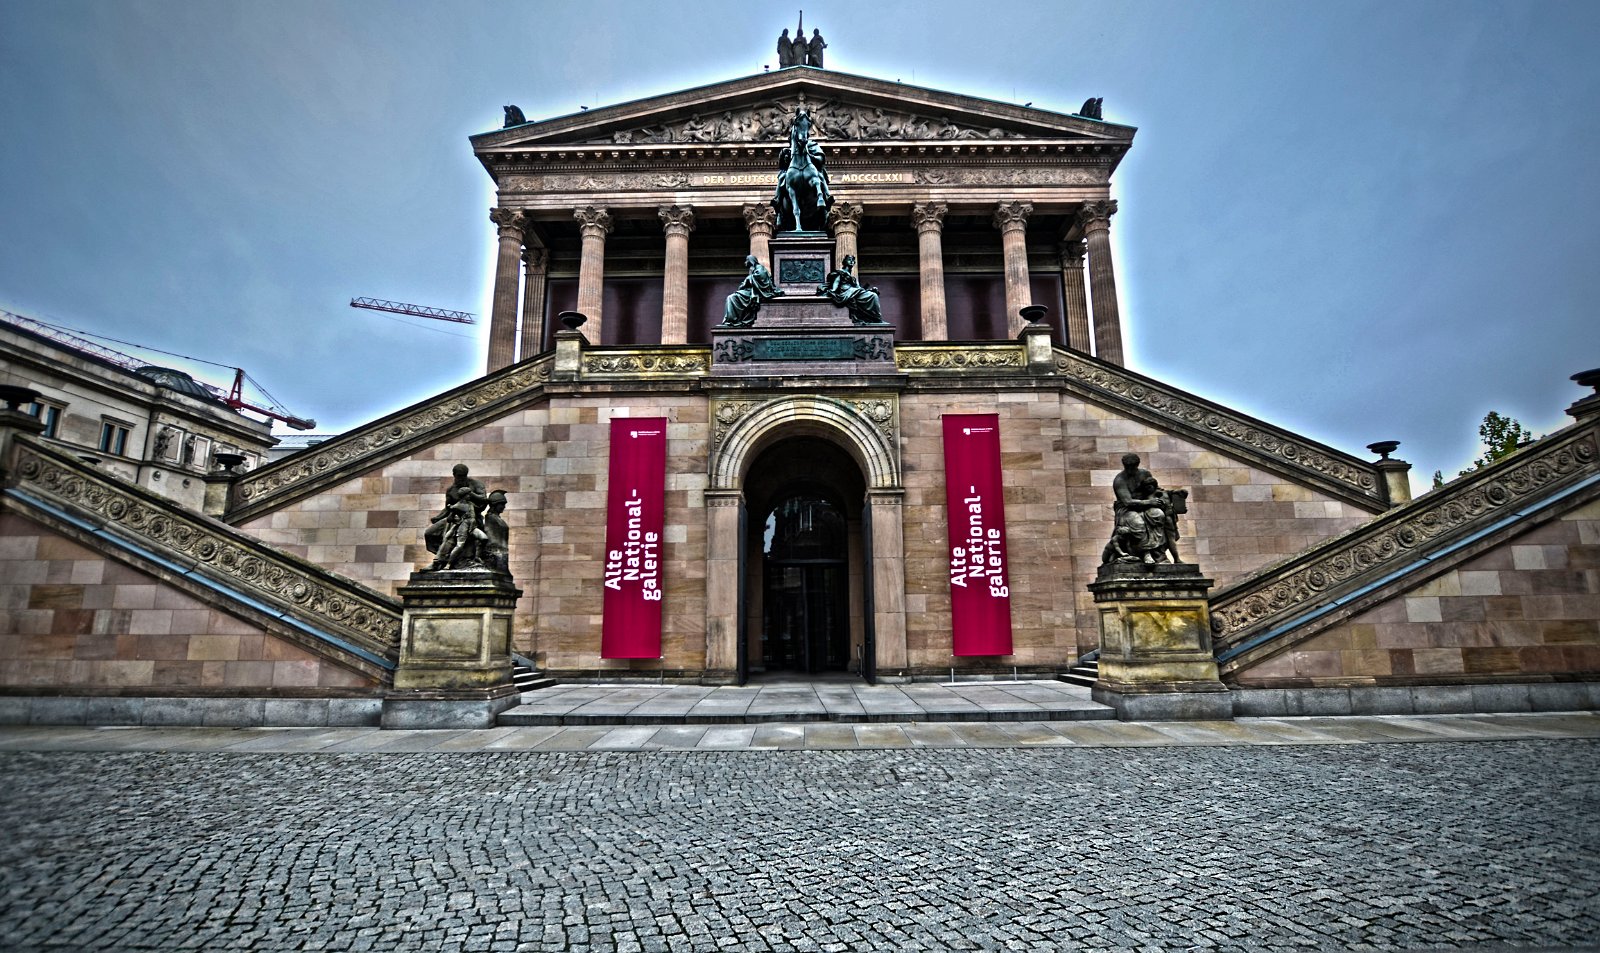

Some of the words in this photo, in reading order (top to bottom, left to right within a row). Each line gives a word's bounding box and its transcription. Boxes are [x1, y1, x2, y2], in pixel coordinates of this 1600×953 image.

[703, 175, 725, 184] DER
[841, 173, 903, 182] MDCCCLXXI
[623, 488, 642, 581] National-
[640, 531, 662, 601] galerie
[964, 485, 985, 578] National-
[984, 528, 1009, 598] galerie
[604, 549, 623, 591] Alte
[950, 546, 968, 588] Alte
